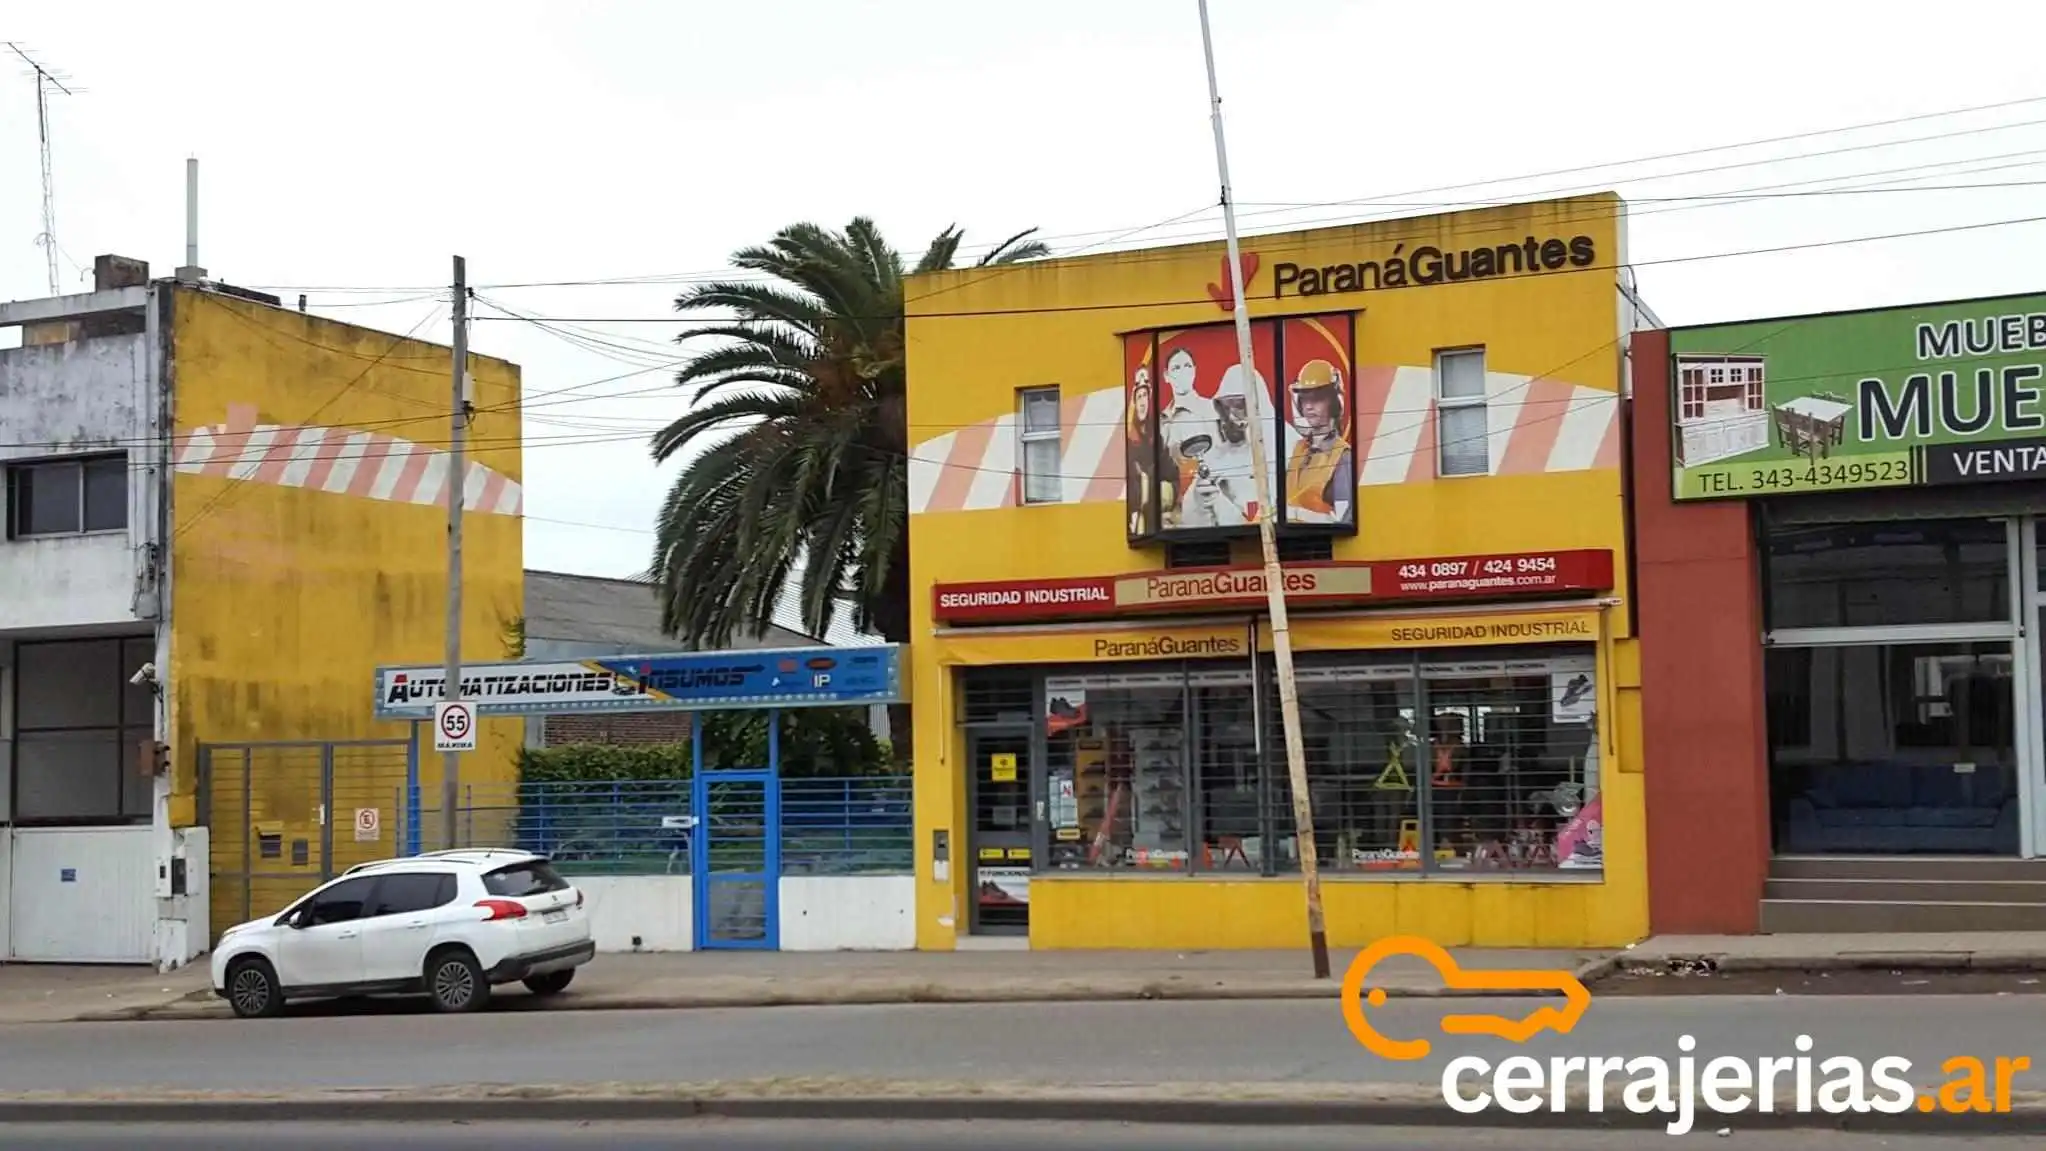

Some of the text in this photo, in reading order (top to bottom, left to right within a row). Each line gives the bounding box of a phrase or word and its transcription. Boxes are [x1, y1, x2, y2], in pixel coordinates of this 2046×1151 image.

[1273, 235, 1595, 299] ParanáGuantes
[1858, 365, 2046, 441] MUE
[1699, 460, 1908, 493] TEL. 343-4349523
[1398, 564, 1426, 578] 434
[1431, 562, 1468, 576] 0897
[1484, 559, 1512, 574] 424
[1517, 557, 1556, 572] 9454
[1148, 571, 1316, 599] ParanaGuates
[1400, 574, 1556, 592] www.paranaguantes.com.ar
[940, 586, 1110, 608] SEGURIDAD INDUSTRIAL
[1391, 620, 1591, 642] SEGURIDAD INDUSTRIAL
[1094, 636, 1240, 658] ParanáGuantes
[446, 715, 465, 732] 55
